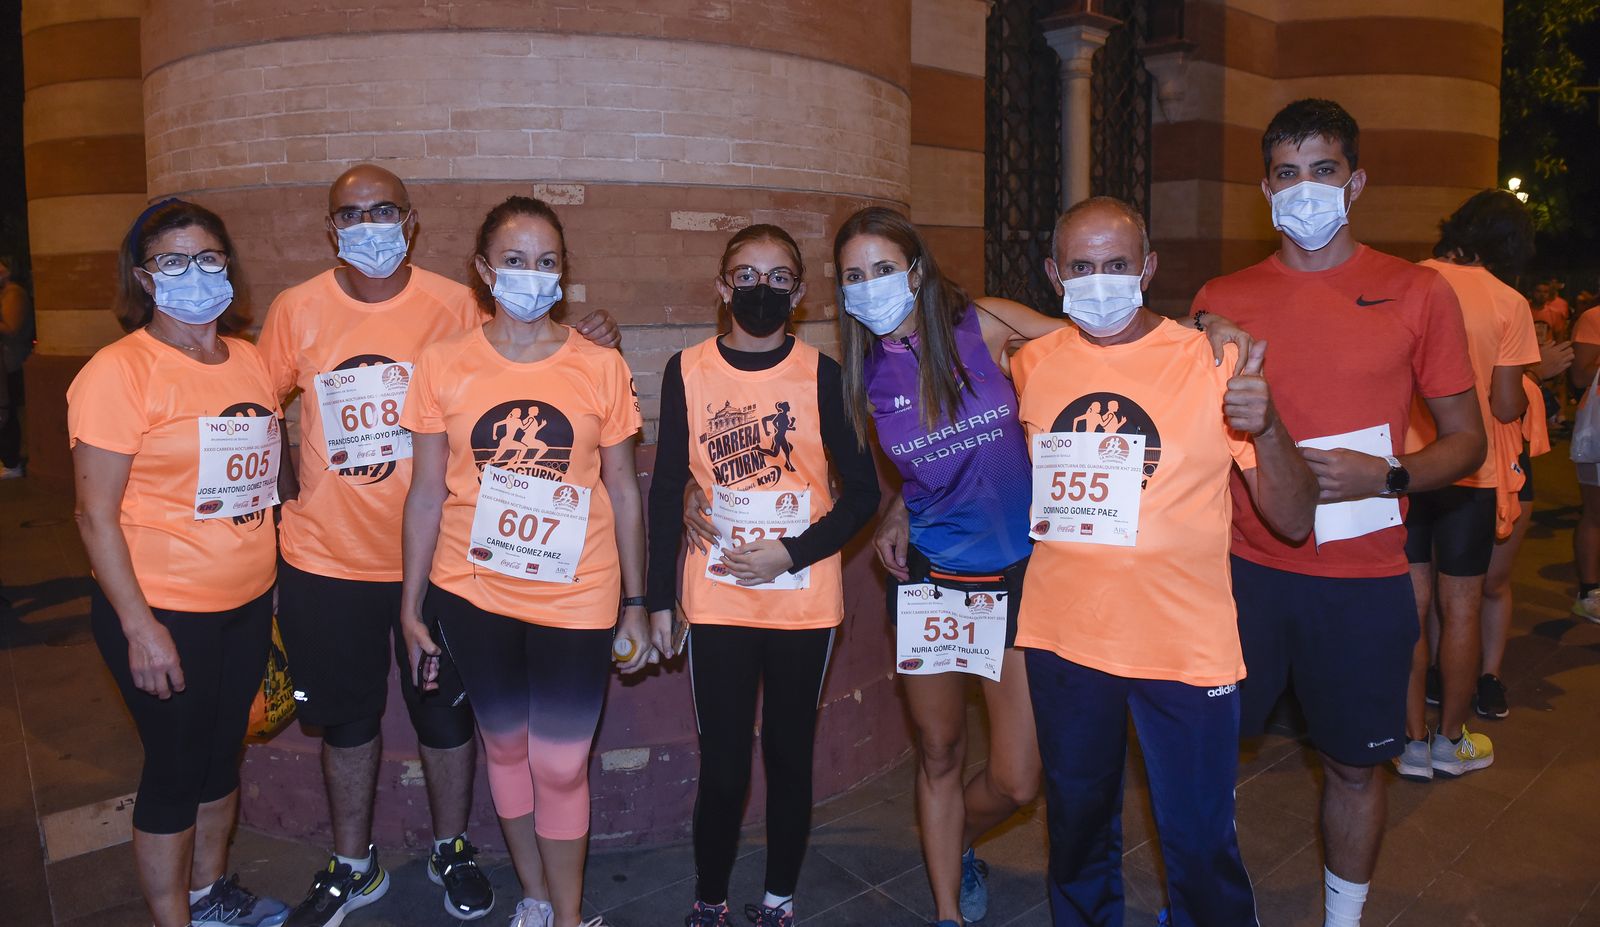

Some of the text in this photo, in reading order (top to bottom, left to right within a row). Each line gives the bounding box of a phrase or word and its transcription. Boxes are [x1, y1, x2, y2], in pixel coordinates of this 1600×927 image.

[341, 399, 399, 432] 608
[891, 404, 1010, 456] GUERRERAS
[328, 436, 359, 447] FRANCISCO
[708, 423, 760, 463] CARRERA
[911, 428, 1003, 467] PEDRERA
[226, 449, 271, 481] 605
[218, 486, 245, 494] ANTONIO
[247, 482, 262, 491] GOMEZ
[1051, 471, 1109, 502] 555
[498, 508, 560, 545] 607
[1043, 506, 1118, 517] DOMINGO GOMEZ PAEZ
[486, 537, 514, 551] CARMEN
[516, 546, 542, 557] GOMEZ
[543, 551, 562, 560] PAEZ
[923, 616, 975, 645] 531
[911, 645, 932, 654] NURIA
[957, 646, 989, 656] TRUJILLO
[1207, 684, 1237, 697] adidas
